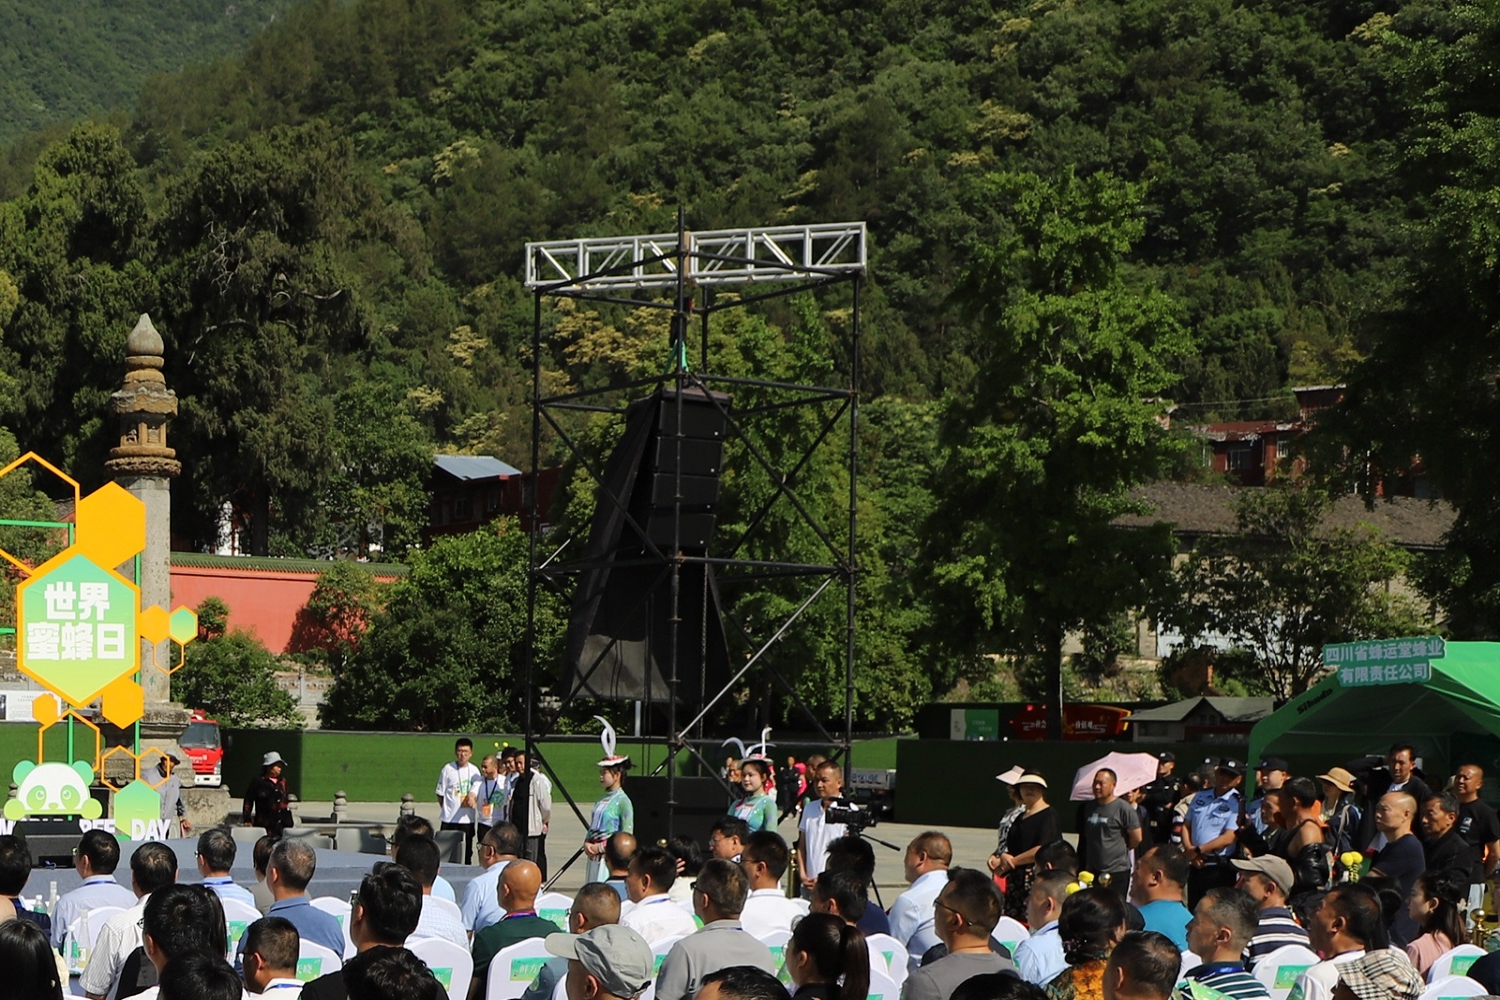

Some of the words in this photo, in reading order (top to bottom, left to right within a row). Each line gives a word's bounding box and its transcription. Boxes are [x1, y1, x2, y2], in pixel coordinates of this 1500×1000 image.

[44, 581, 110, 621] 世界
[27, 622, 126, 661] 蜜蜂日
[1340, 663, 1429, 684] 有限责任公司
[131, 818, 172, 841] DAY
